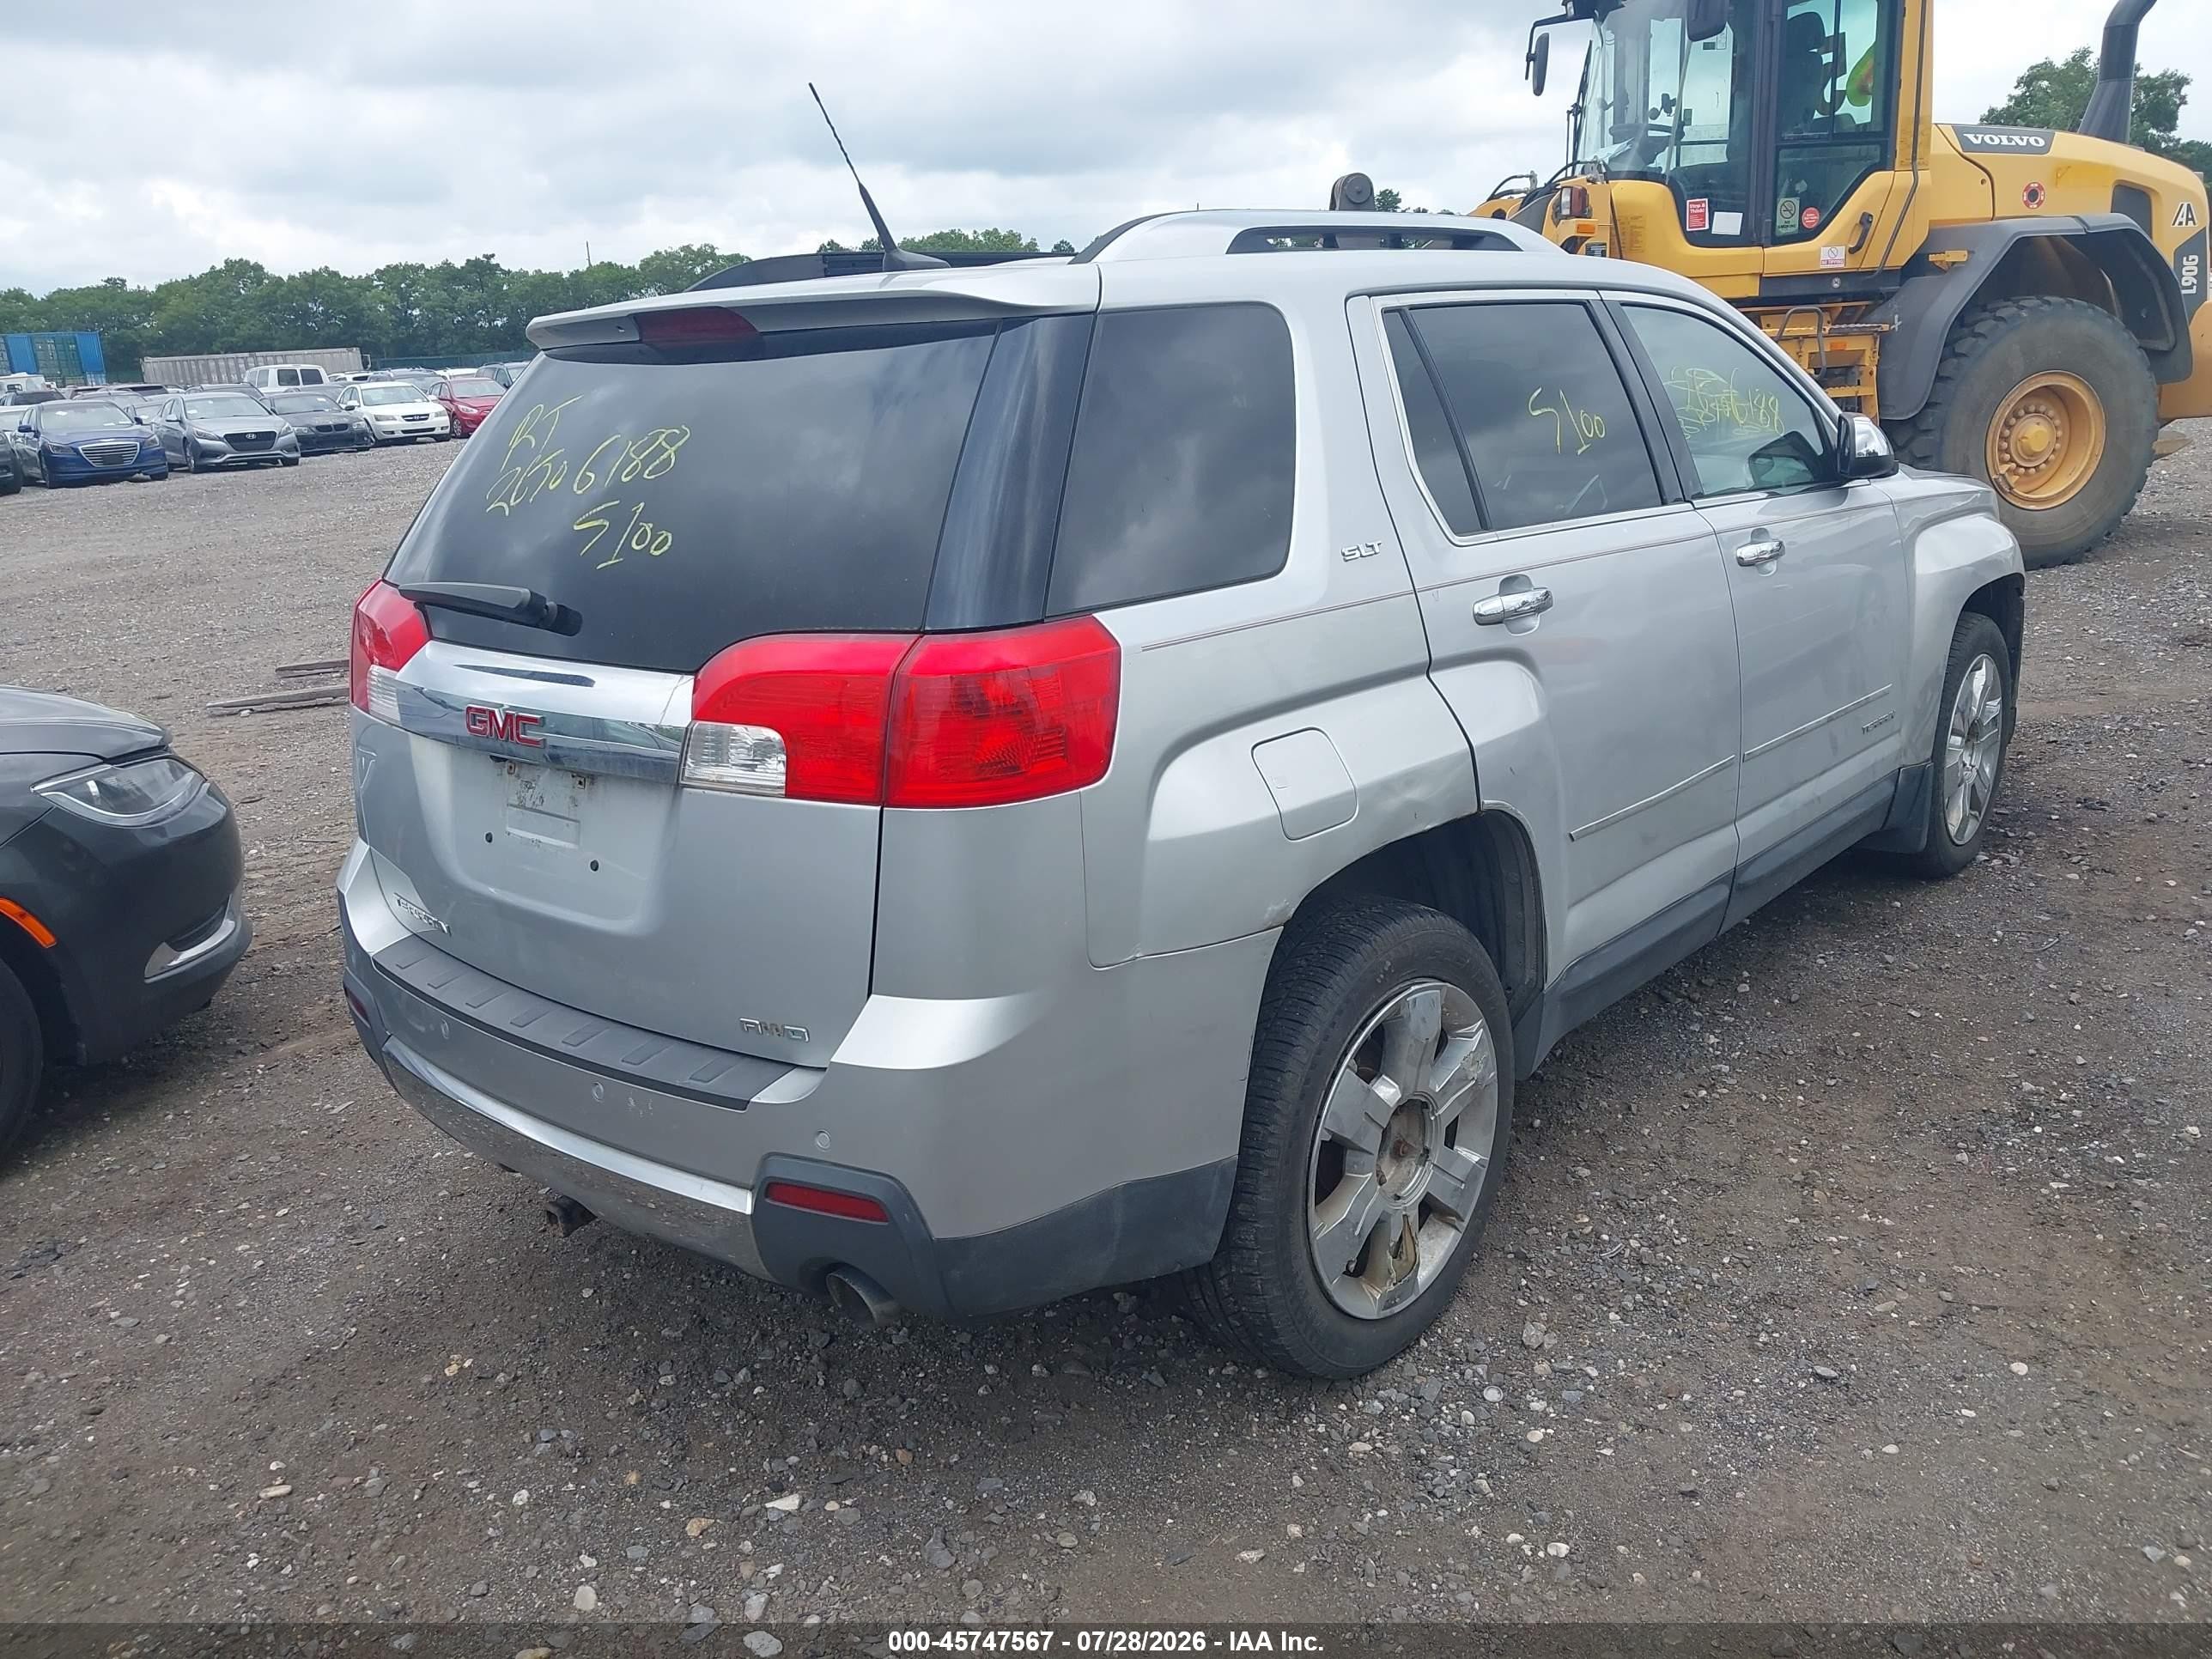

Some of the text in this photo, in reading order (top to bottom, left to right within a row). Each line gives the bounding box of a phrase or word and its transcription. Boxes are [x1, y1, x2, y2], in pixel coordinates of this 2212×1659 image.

[1963, 133, 2045, 148] VOLVO
[2181, 255, 2199, 295] L90G
[1341, 541, 1382, 562] SLT
[466, 704, 544, 749] GMC
